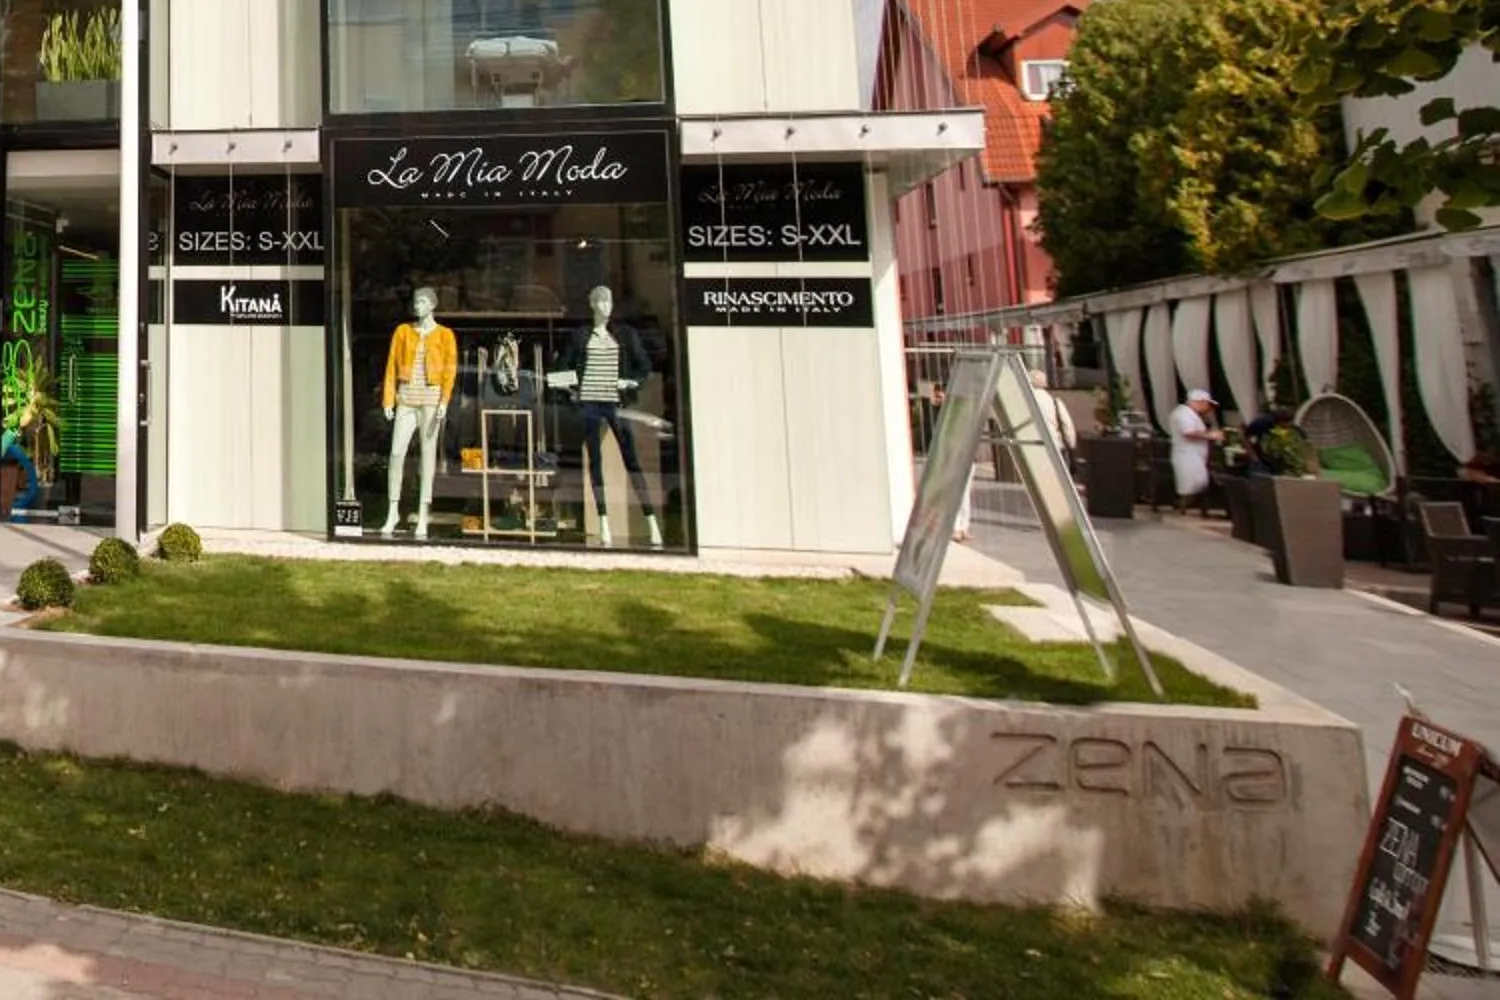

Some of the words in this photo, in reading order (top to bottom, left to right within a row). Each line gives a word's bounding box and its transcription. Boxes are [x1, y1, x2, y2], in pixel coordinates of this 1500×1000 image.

[367, 147, 423, 188] La
[430, 147, 512, 186] Mia
[519, 145, 628, 185] Moda
[179, 231, 251, 251] SIZES:
[259, 231, 325, 251] S-XXL
[688, 225, 773, 247] SIZES:
[781, 223, 861, 246] S-XXL
[703, 291, 854, 306] RINASCIMENTO
